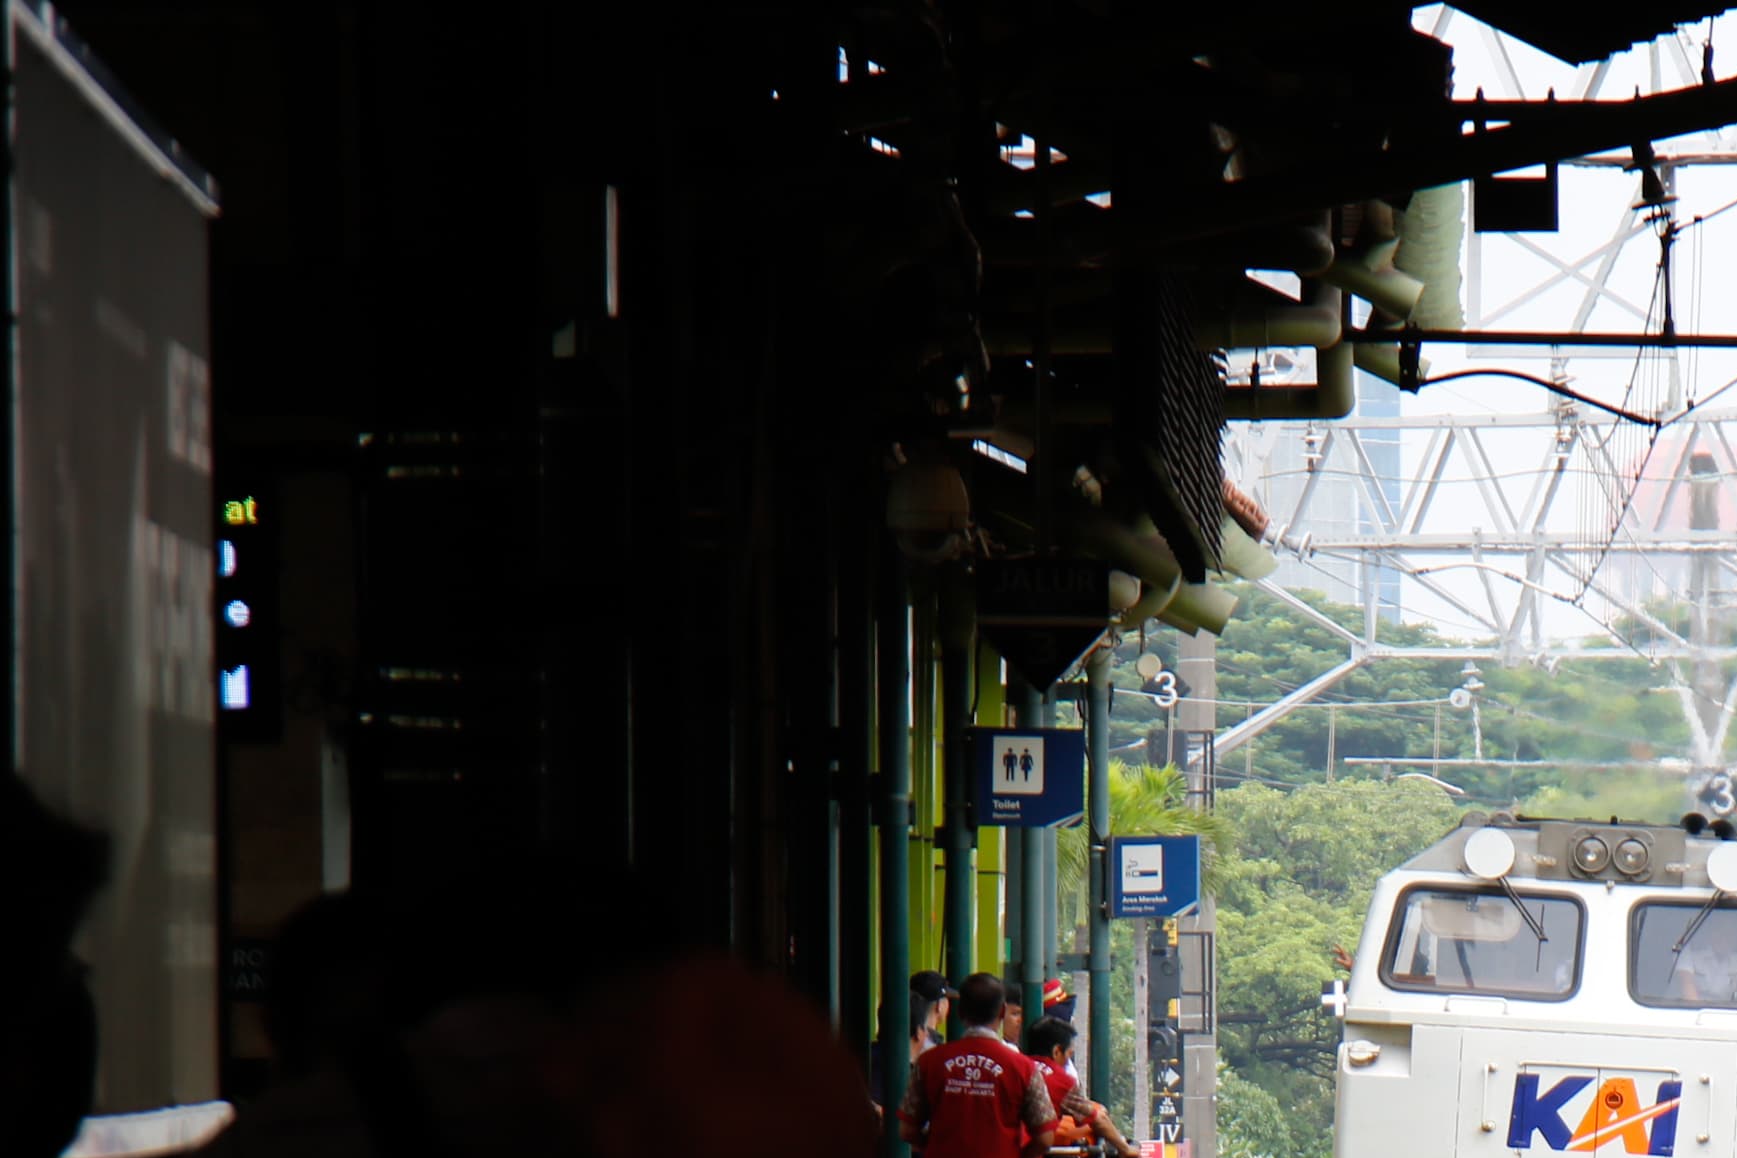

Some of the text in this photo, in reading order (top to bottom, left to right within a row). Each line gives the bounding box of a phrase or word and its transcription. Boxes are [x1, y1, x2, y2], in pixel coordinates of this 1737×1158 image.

[1154, 671, 1177, 706] 3
[992, 799, 1020, 809] Toilet
[1711, 776, 1736, 813] 3
[944, 1054, 1004, 1077] PORTER
[965, 1067, 981, 1080] 90
[1506, 1073, 1683, 1158] KAI
[1159, 1124, 1181, 1143] IV
